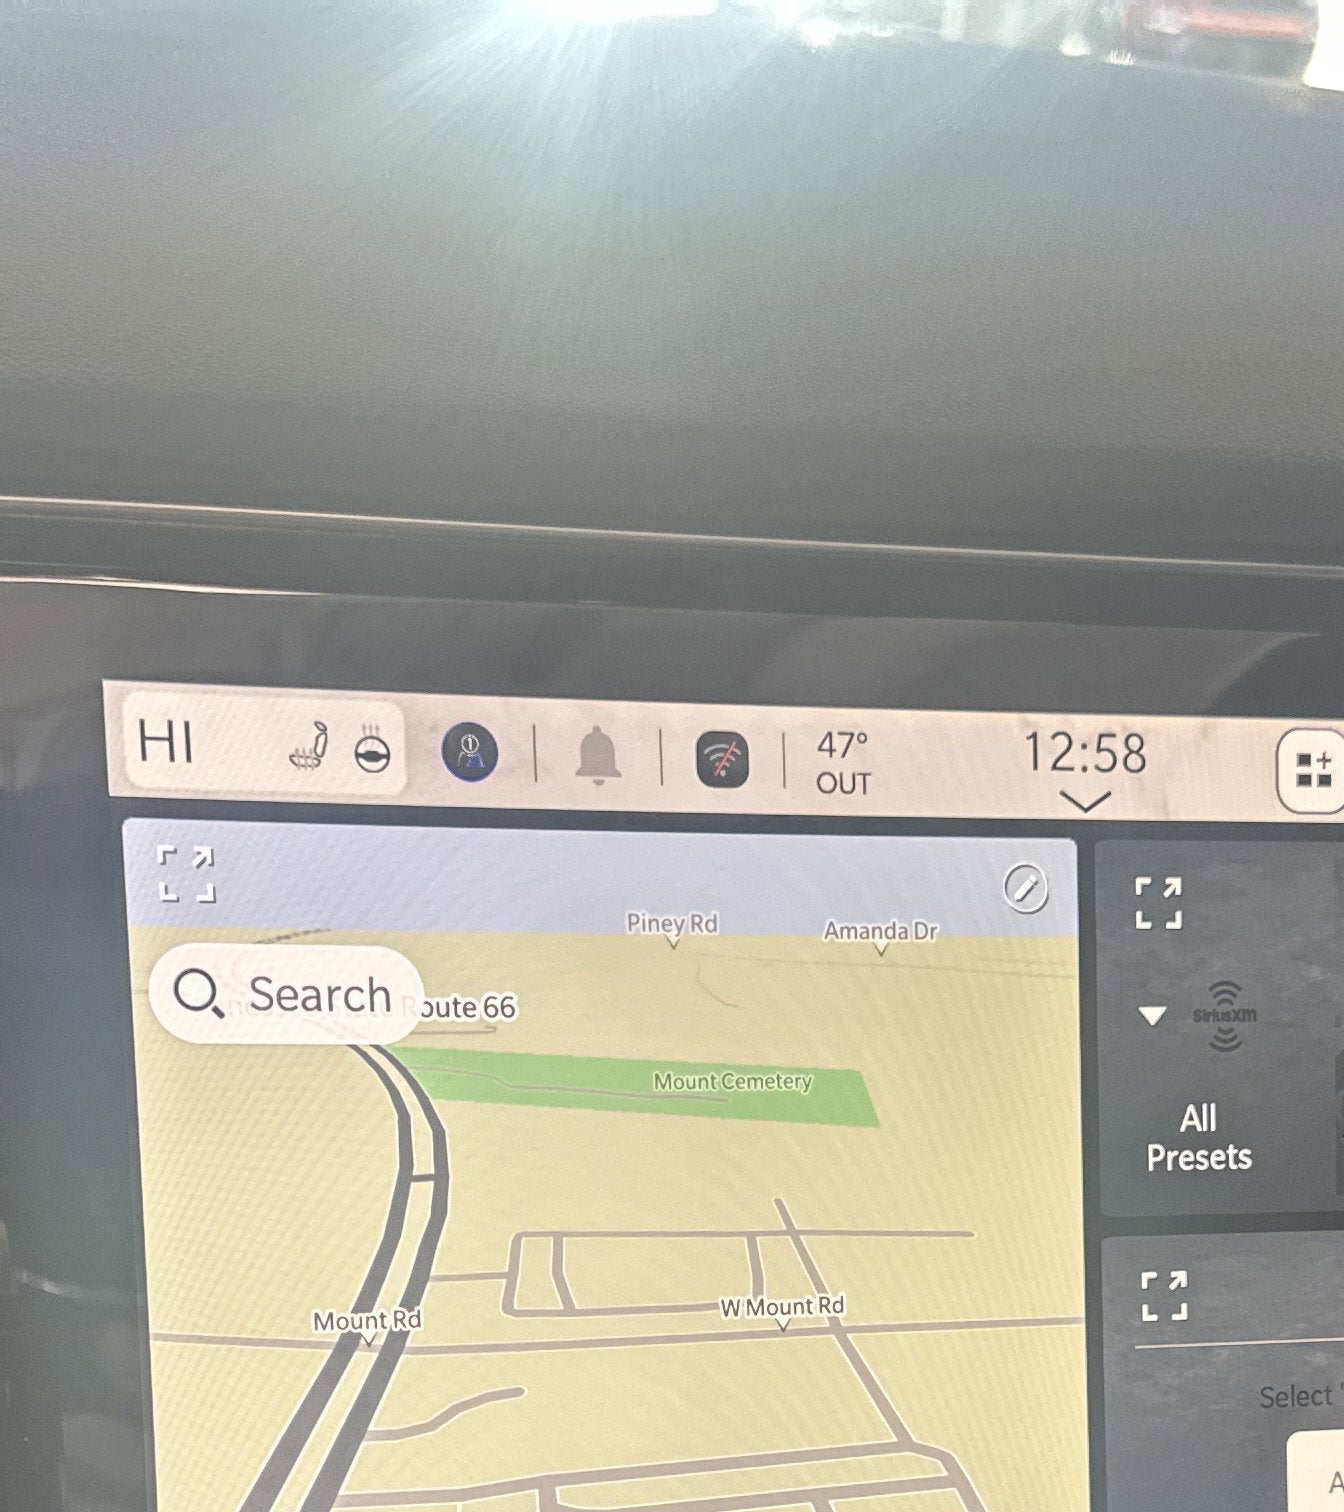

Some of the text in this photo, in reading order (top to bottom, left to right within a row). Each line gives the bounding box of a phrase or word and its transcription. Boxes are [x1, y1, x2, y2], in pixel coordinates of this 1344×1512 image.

[136, 719, 194, 764] HI
[1025, 731, 1147, 774] 12:58
[816, 772, 871, 796] OUT
[627, 911, 719, 939] Piney Rd
[824, 919, 939, 943] Amanda Dr
[249, 974, 392, 1013] Search
[482, 996, 517, 1019] 66
[654, 1069, 813, 1096] Mount Cemetery
[1180, 1102, 1217, 1132] All
[1147, 1143, 1253, 1172] Presets
[720, 1294, 845, 1318] W Mount Rd
[312, 1307, 423, 1333] Mount Rd
[1259, 1385, 1332, 1410] Select
